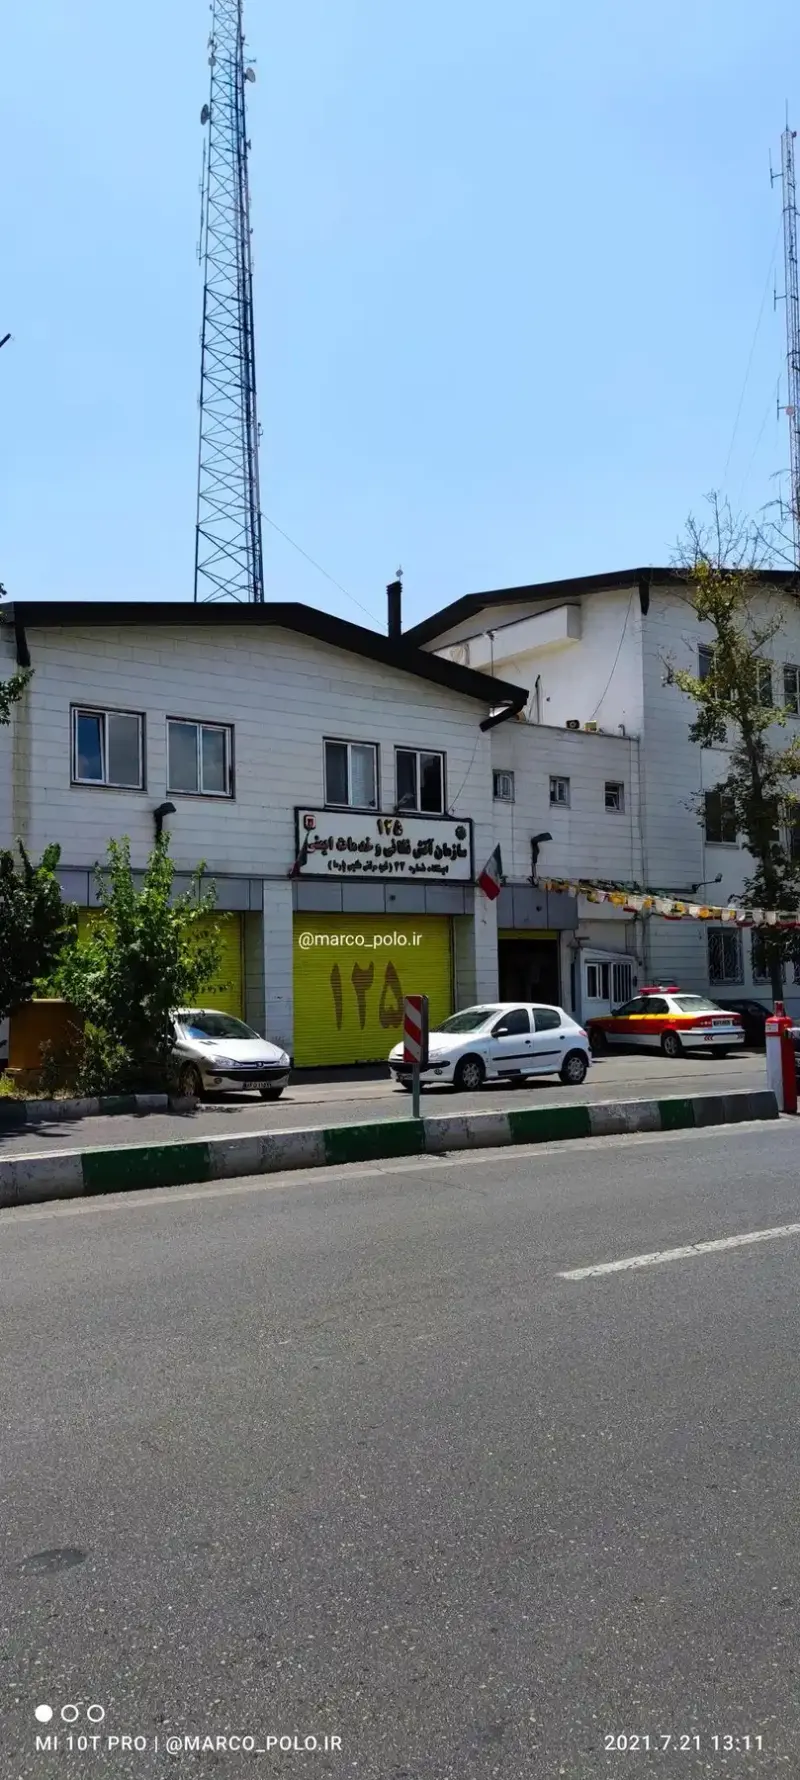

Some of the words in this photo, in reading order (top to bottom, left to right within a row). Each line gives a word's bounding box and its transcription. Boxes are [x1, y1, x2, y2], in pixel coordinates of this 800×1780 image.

[377, 819, 403, 836] ۱۲۵
[307, 835, 333, 856] ایمنی
[336, 836, 373, 853] خدمات
[374, 843, 381, 857] و
[383, 838, 411, 857] نشانی
[412, 838, 434, 859] آتش
[434, 842, 467, 861] سازمان
[408, 862, 426, 875] شماره
[427, 864, 449, 876] ایستگاه
[330, 961, 404, 1031] ۱۲۵
